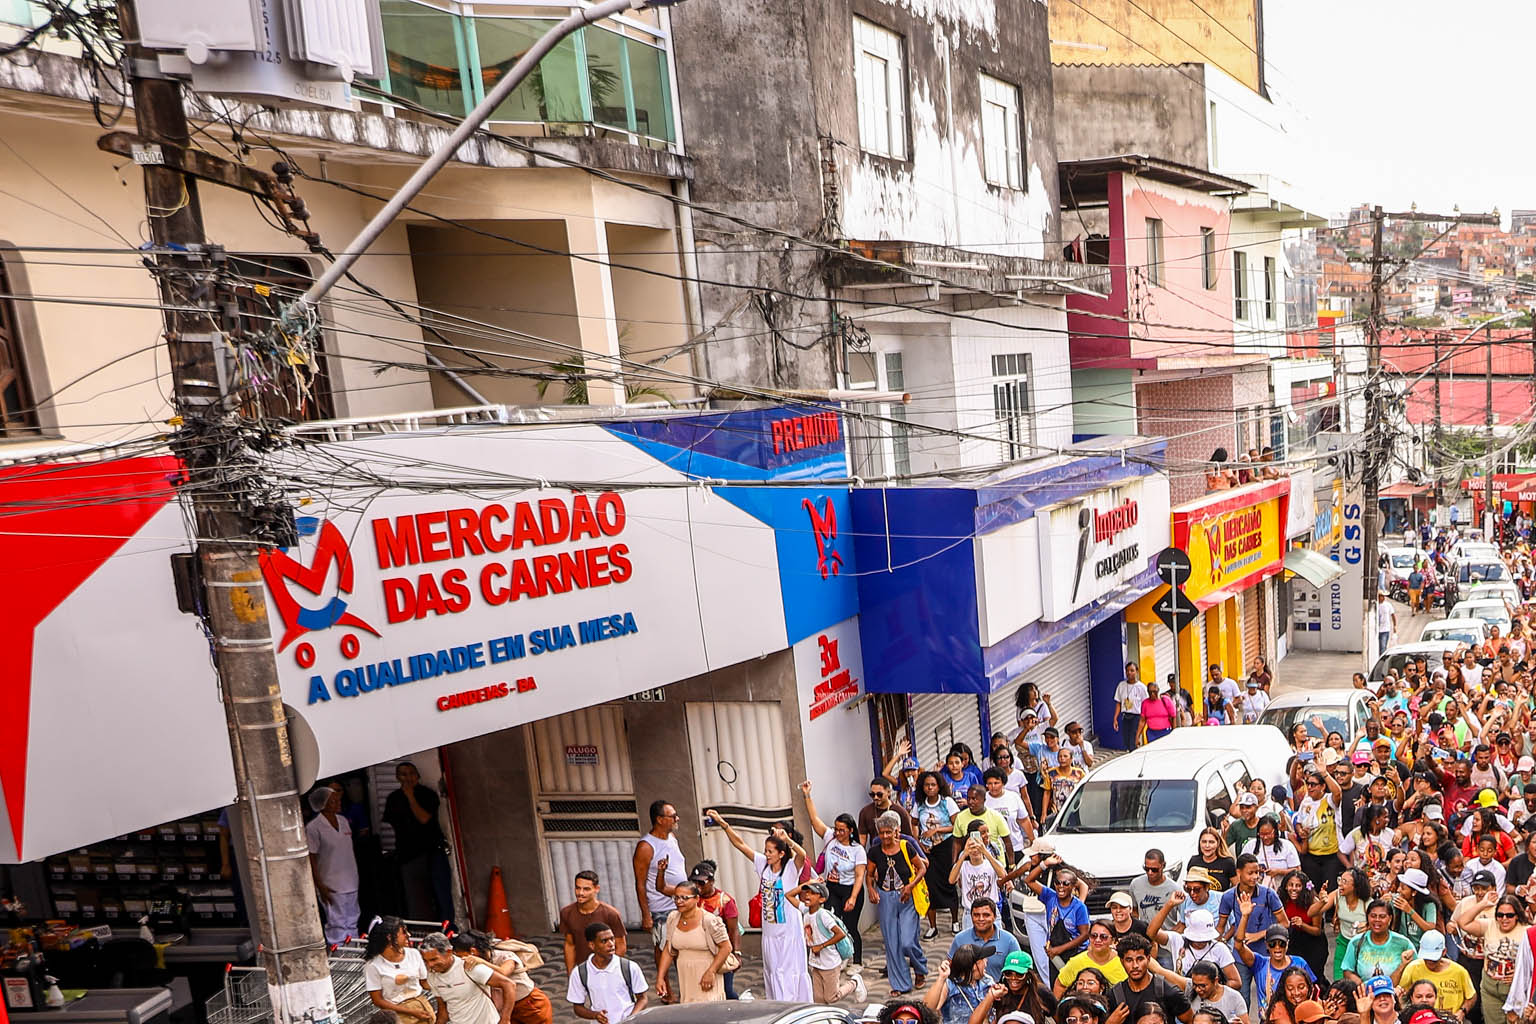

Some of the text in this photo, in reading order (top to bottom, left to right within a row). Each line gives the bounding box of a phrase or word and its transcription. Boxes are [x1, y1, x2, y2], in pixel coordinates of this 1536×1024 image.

[771, 411, 840, 455] PREMIUM
[372, 490, 627, 570] MERCADÃO
[1094, 498, 1138, 545] Impacto
[1223, 505, 1262, 542] MERCADÃO
[382, 543, 634, 624] DAS CARNES
[1331, 583, 1342, 631] CENTRO
[308, 611, 640, 705] A QUALIDADE EM SUA MESA
[436, 681, 511, 712] CANDEIAS
[517, 676, 538, 694] BA
[568, 746, 597, 755] ALUGO
[1143, 894, 1162, 903] NIKE
